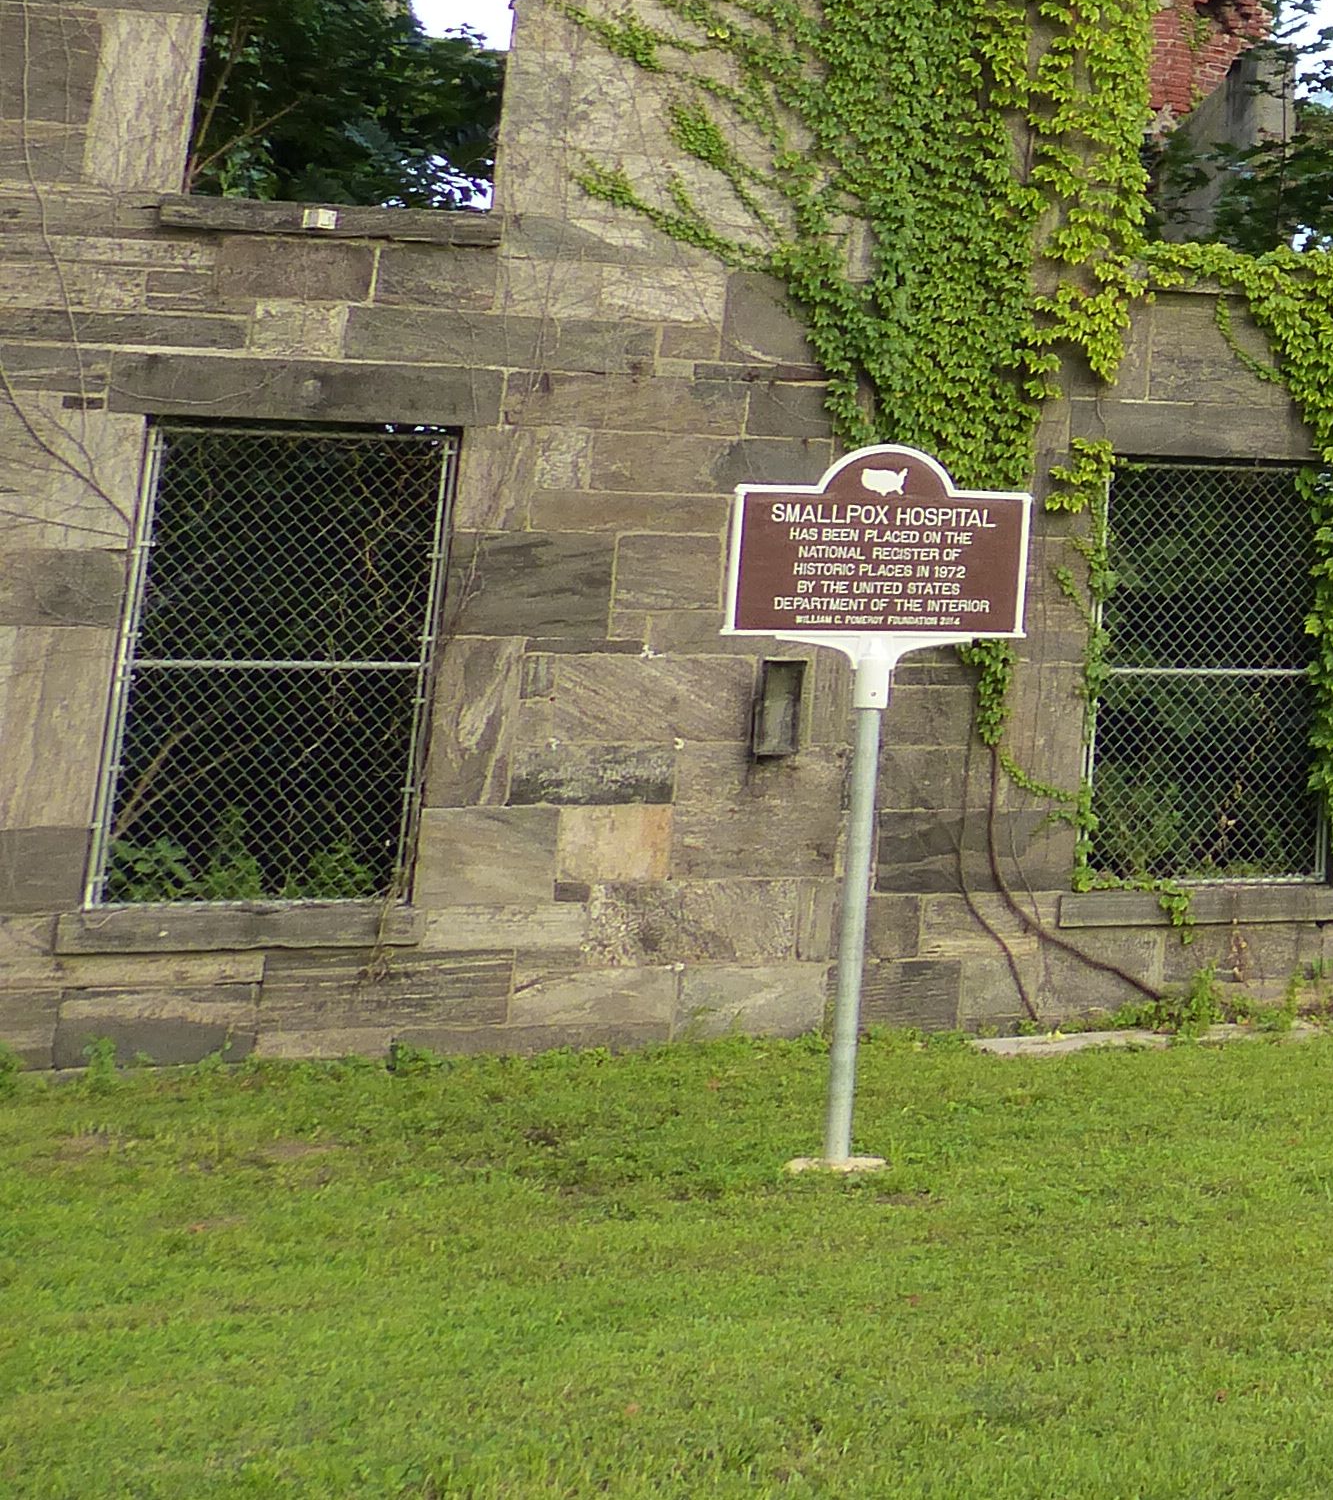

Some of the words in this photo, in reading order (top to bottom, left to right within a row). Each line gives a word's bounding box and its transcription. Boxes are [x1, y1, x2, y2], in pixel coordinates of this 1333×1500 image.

[771, 503, 889, 525] SMALLPOX
[896, 507, 996, 528] HOSPITAL
[789, 528, 817, 540] HAS
[822, 529, 858, 542] BEEN
[865, 530, 919, 543] PLACED
[923, 531, 942, 544] ON
[945, 532, 972, 544] THE
[798, 546, 865, 559] NATIONAL
[873, 547, 938, 560] REGISTER
[943, 549, 962, 561] OF
[793, 563, 855, 576] HISTORIC
[859, 564, 912, 577] PLACES
[917, 565, 930, 578] IN
[934, 566, 965, 578] 1972
[797, 581, 816, 593] BY
[821, 581, 847, 593] THE
[853, 582, 902, 594] UNITED
[908, 582, 960, 595] STATES
[774, 597, 866, 610] DEPARTMENT
[871, 598, 888, 611] OF
[895, 599, 922, 612] THE
[927, 600, 989, 613] INTERIOR
[796, 615, 832, 624] WILLIAM
[888, 616, 937, 625] FOUNDATION
